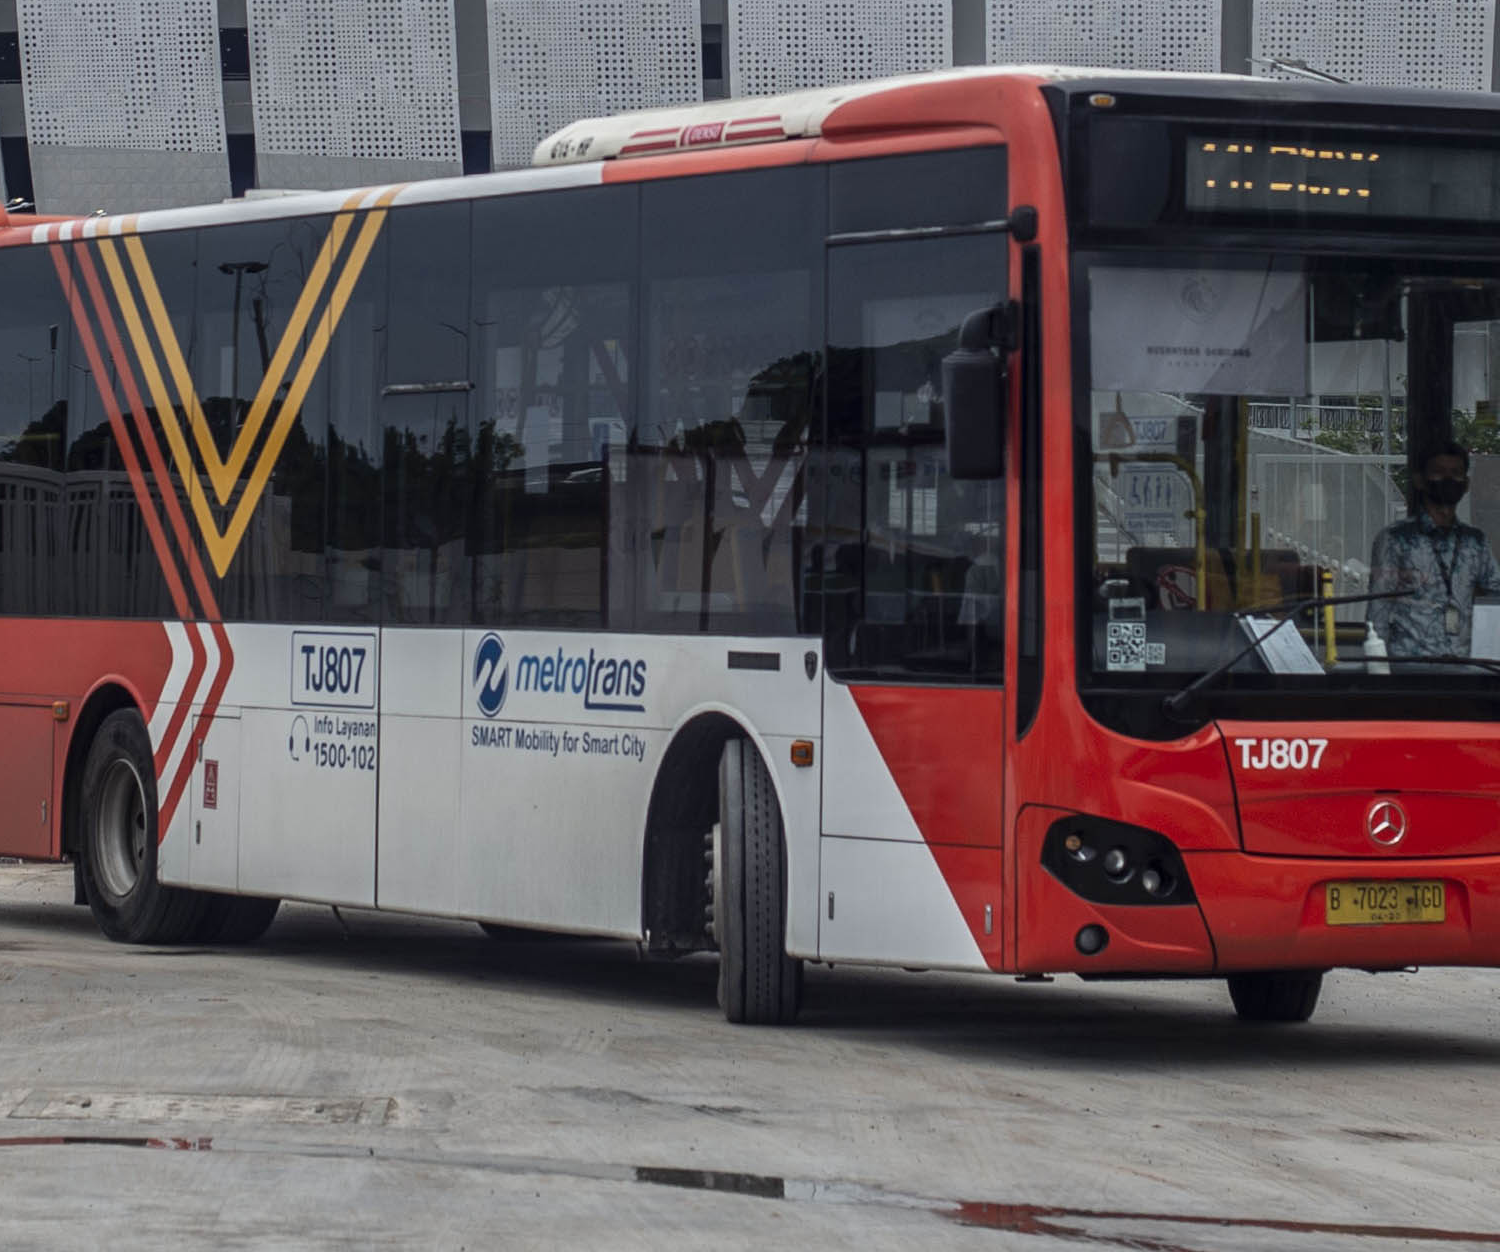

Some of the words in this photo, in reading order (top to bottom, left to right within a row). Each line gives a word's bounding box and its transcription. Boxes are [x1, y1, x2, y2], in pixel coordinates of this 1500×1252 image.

[301, 645, 366, 694] TJ807
[516, 646, 647, 710] metrotrans
[315, 715, 333, 734] Info
[336, 719, 376, 740] Layanan
[472, 725, 513, 749] SMART
[515, 728, 560, 757] Mobility
[563, 730, 579, 753] for
[582, 731, 619, 755] Smart
[621, 734, 646, 762] City
[1234, 738, 1328, 769] TJ807
[1330, 887, 1341, 911] B
[1357, 886, 1398, 910] 7023
[1411, 884, 1443, 908] TGD
